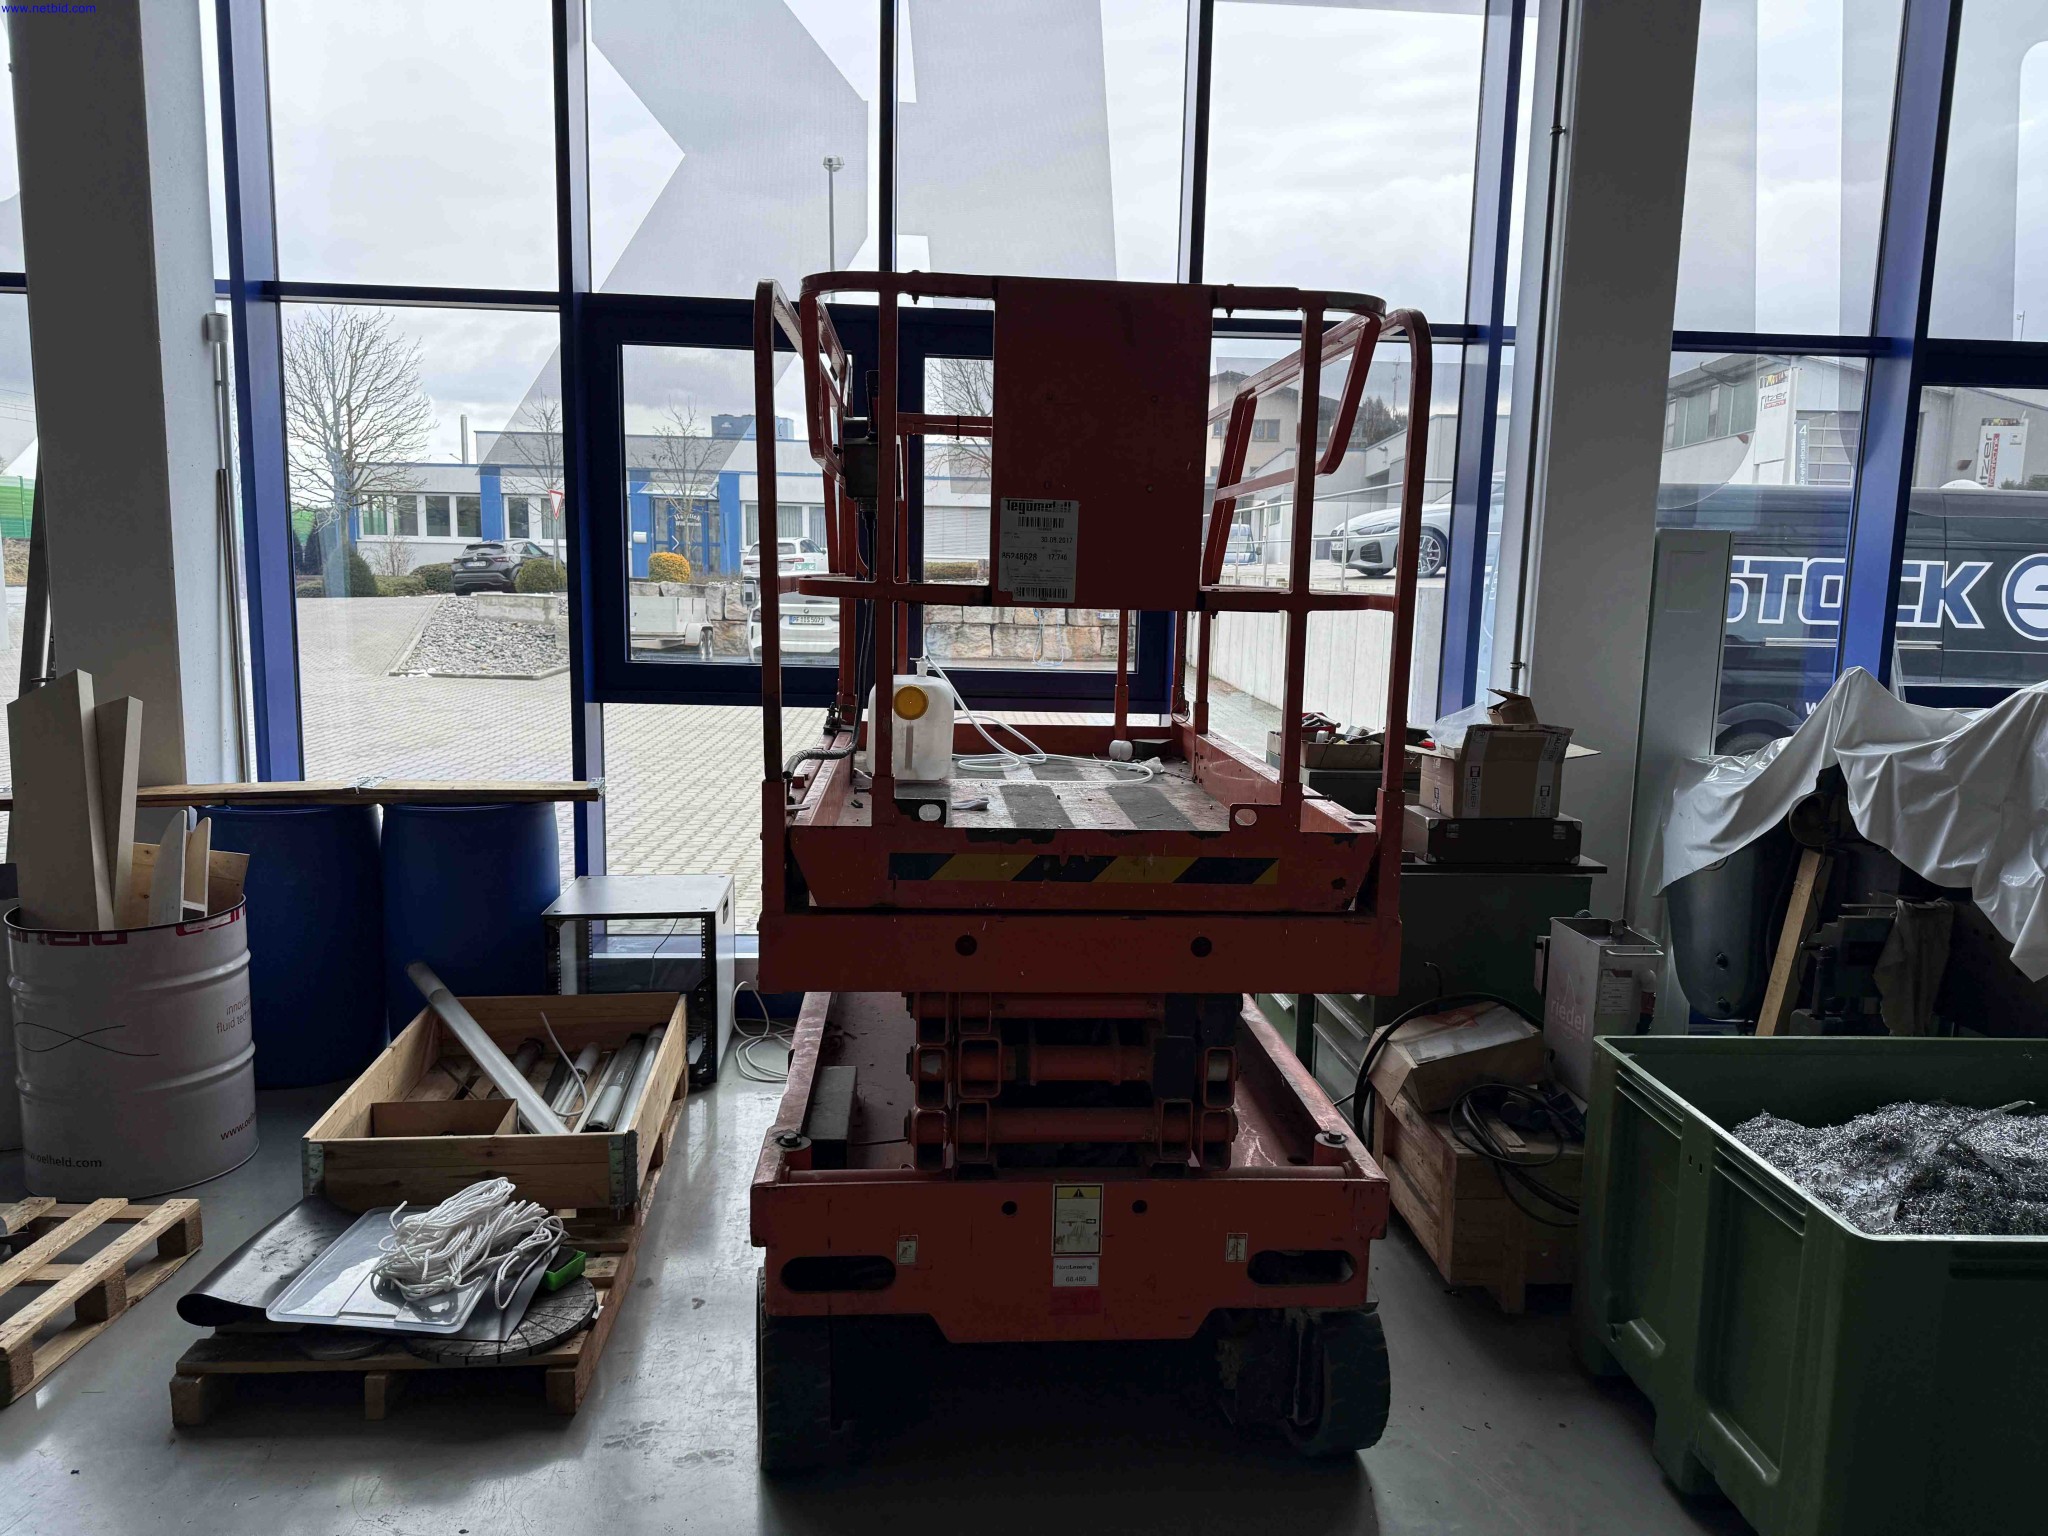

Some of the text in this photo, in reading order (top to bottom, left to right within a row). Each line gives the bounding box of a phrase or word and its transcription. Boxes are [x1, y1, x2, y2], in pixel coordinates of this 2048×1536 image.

[1760, 391, 1788, 411] fitzer
[1799, 424, 1808, 436] 4
[1978, 432, 1993, 486] itzer
[1470, 777, 1479, 808] BAUER
[216, 1017, 236, 1035] fluid
[1550, 998, 1586, 1034] riedel
